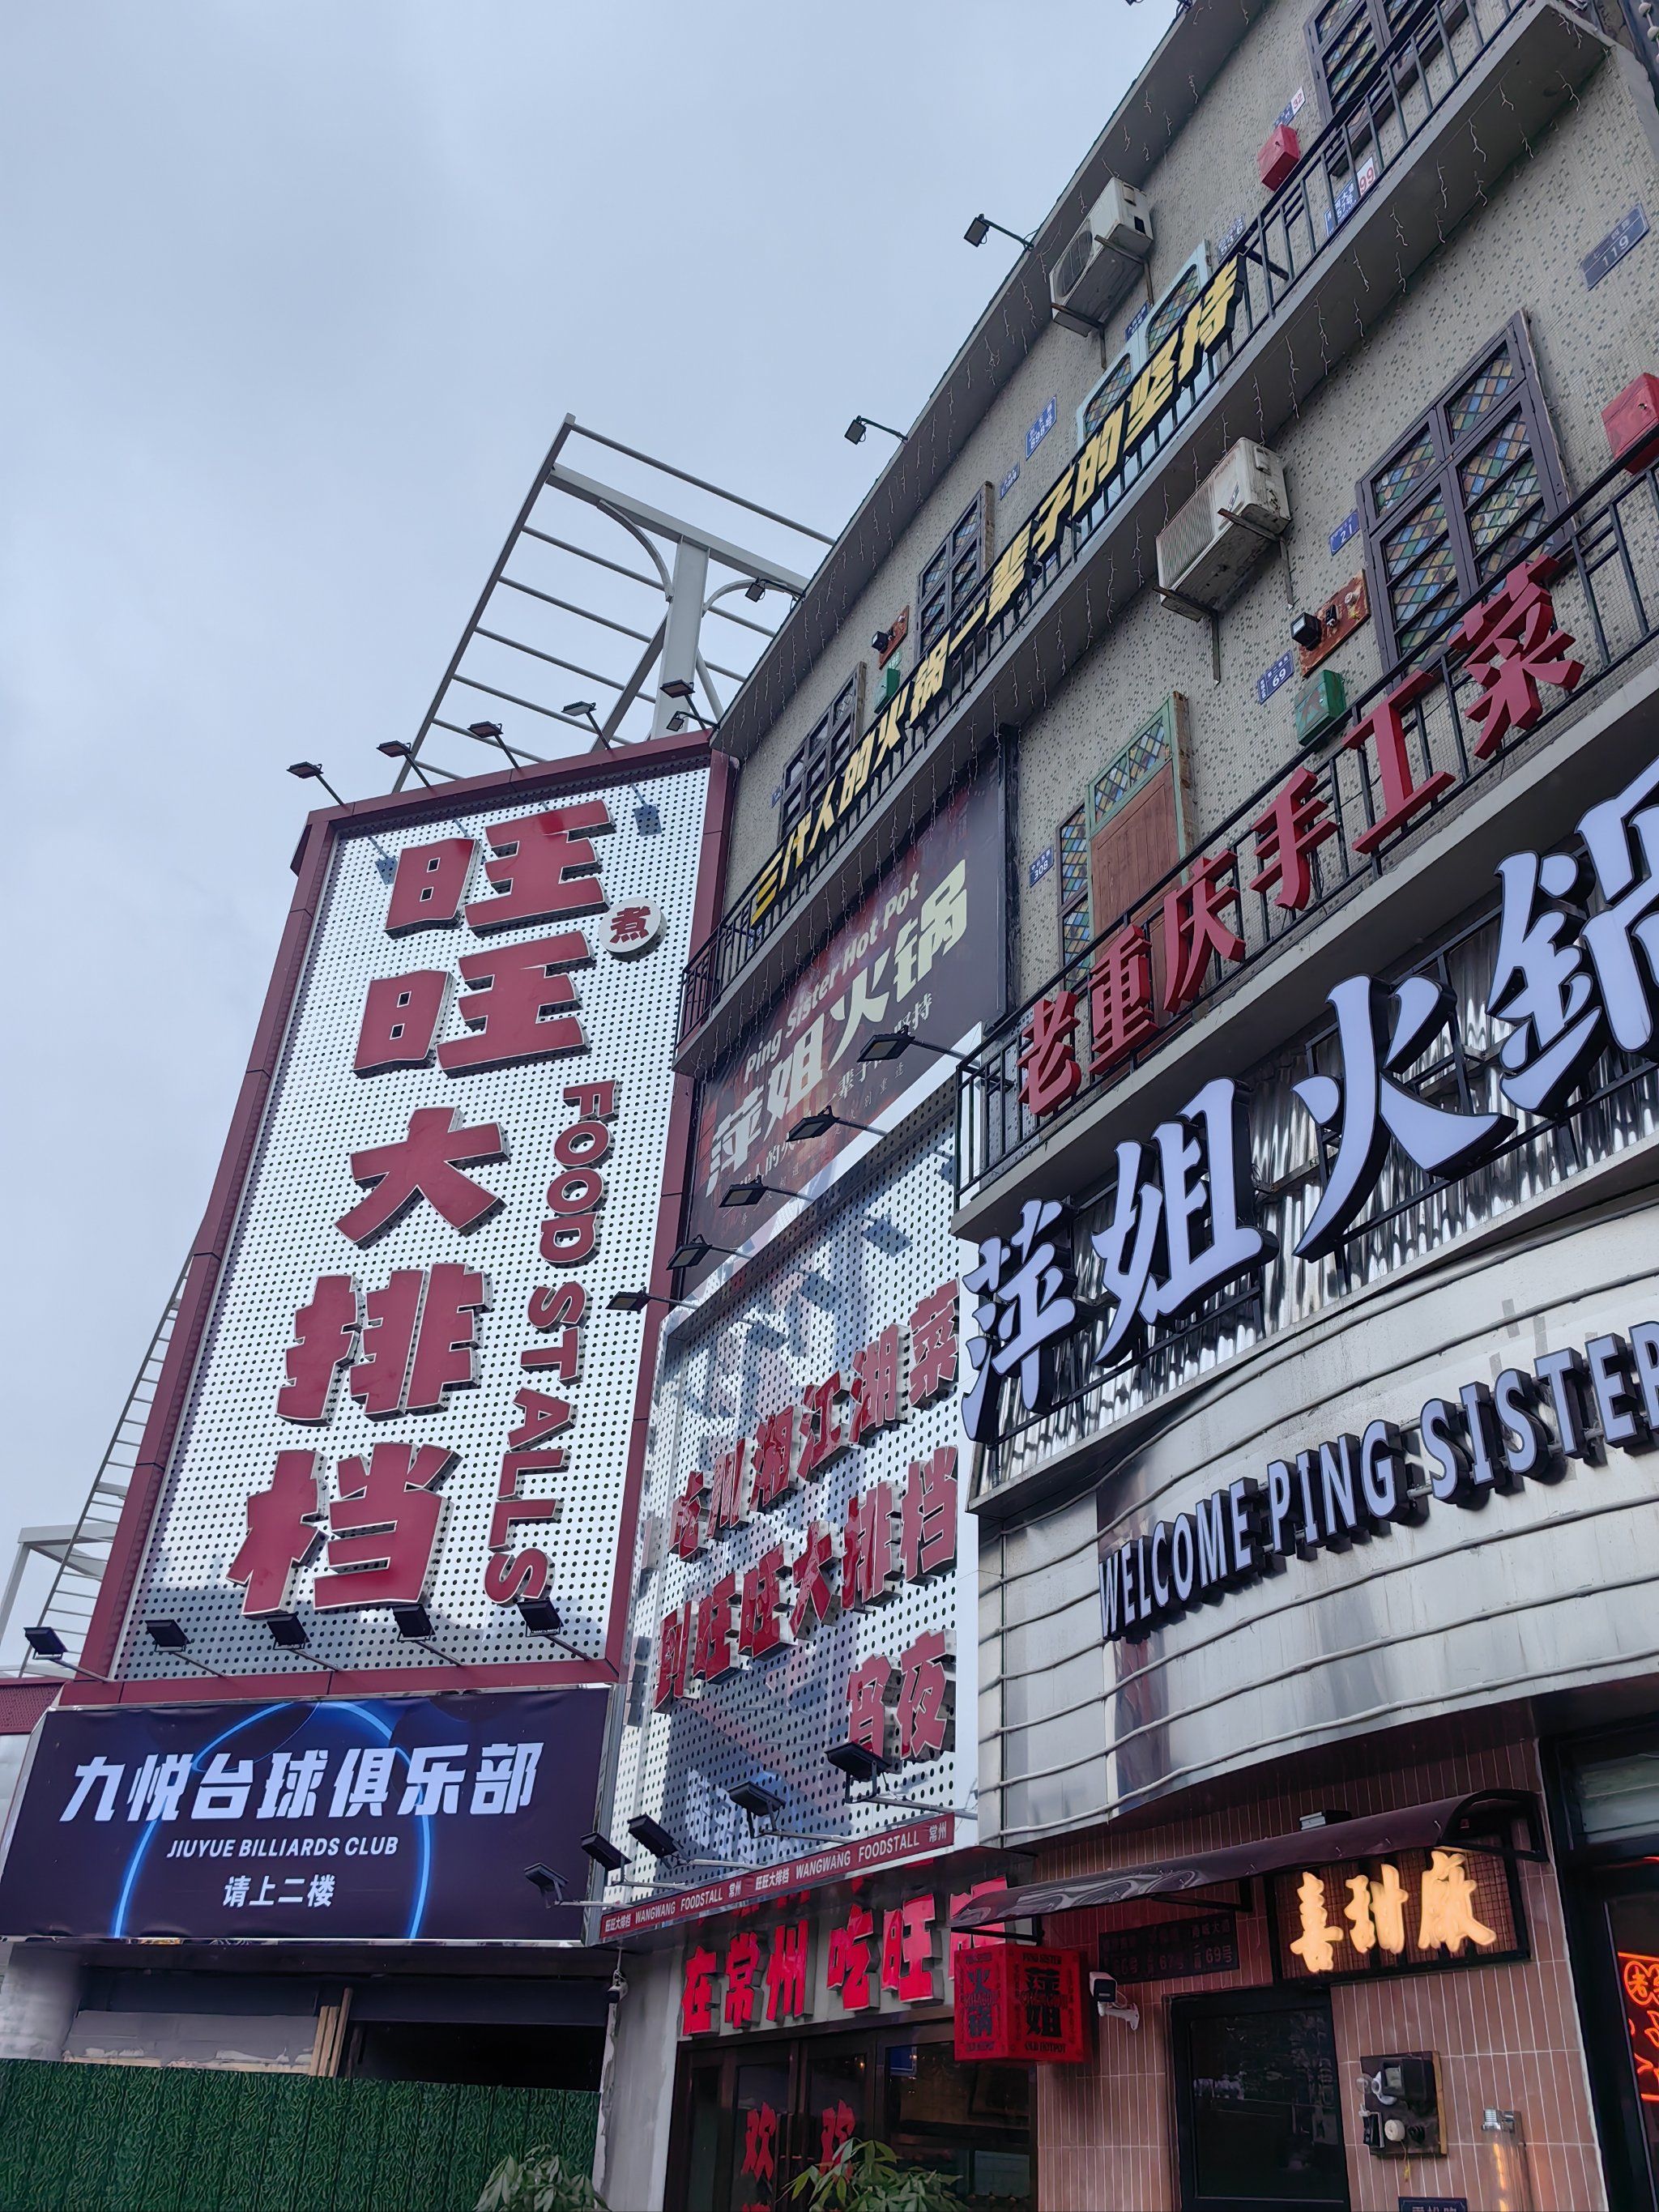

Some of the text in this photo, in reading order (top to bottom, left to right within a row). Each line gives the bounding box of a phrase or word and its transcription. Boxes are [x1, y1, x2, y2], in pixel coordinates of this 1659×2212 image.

[1360, 167, 1375, 194] 99
[1602, 235, 1629, 266] 119
[1341, 523, 1353, 543] 21
[1273, 668, 1286, 687] 69
[1017, 554, 1585, 1117] 老重庆手工菜
[1034, 859, 1048, 880] 308
[609, 906, 651, 944] 煮
[706, 859, 968, 1198] 萍姐火锅
[744, 1029, 783, 1084] Ping
[842, 916, 879, 977] Hot
[883, 870, 919, 931] Pot
[227, 799, 614, 1616] 旺旺大排档
[485, 1078, 617, 1607] FOOD STALLS
[1098, 1320, 1659, 1642] WELCOME PING SISTER
[654, 1446, 959, 1713] 到旺旺大排档
[847, 1630, 954, 1761] 宵夜
[60, 1741, 544, 1822] 九悦台球俱乐部
[166, 1836, 399, 1859] JIUYUE BILLIARDS CLUB
[223, 1875, 336, 1908] 请上二楼
[635, 1901, 676, 1924] WANGWANG
[680, 1888, 723, 1912] FOODSTALL
[728, 1880, 742, 1899] 常州
[755, 1867, 790, 1891] 旺旺大排档
[795, 1851, 851, 1880] WANGWANG
[859, 1830, 920, 1862] FOODSTALL
[929, 1821, 947, 1843] 常州
[682, 1919, 810, 2036] 在常州
